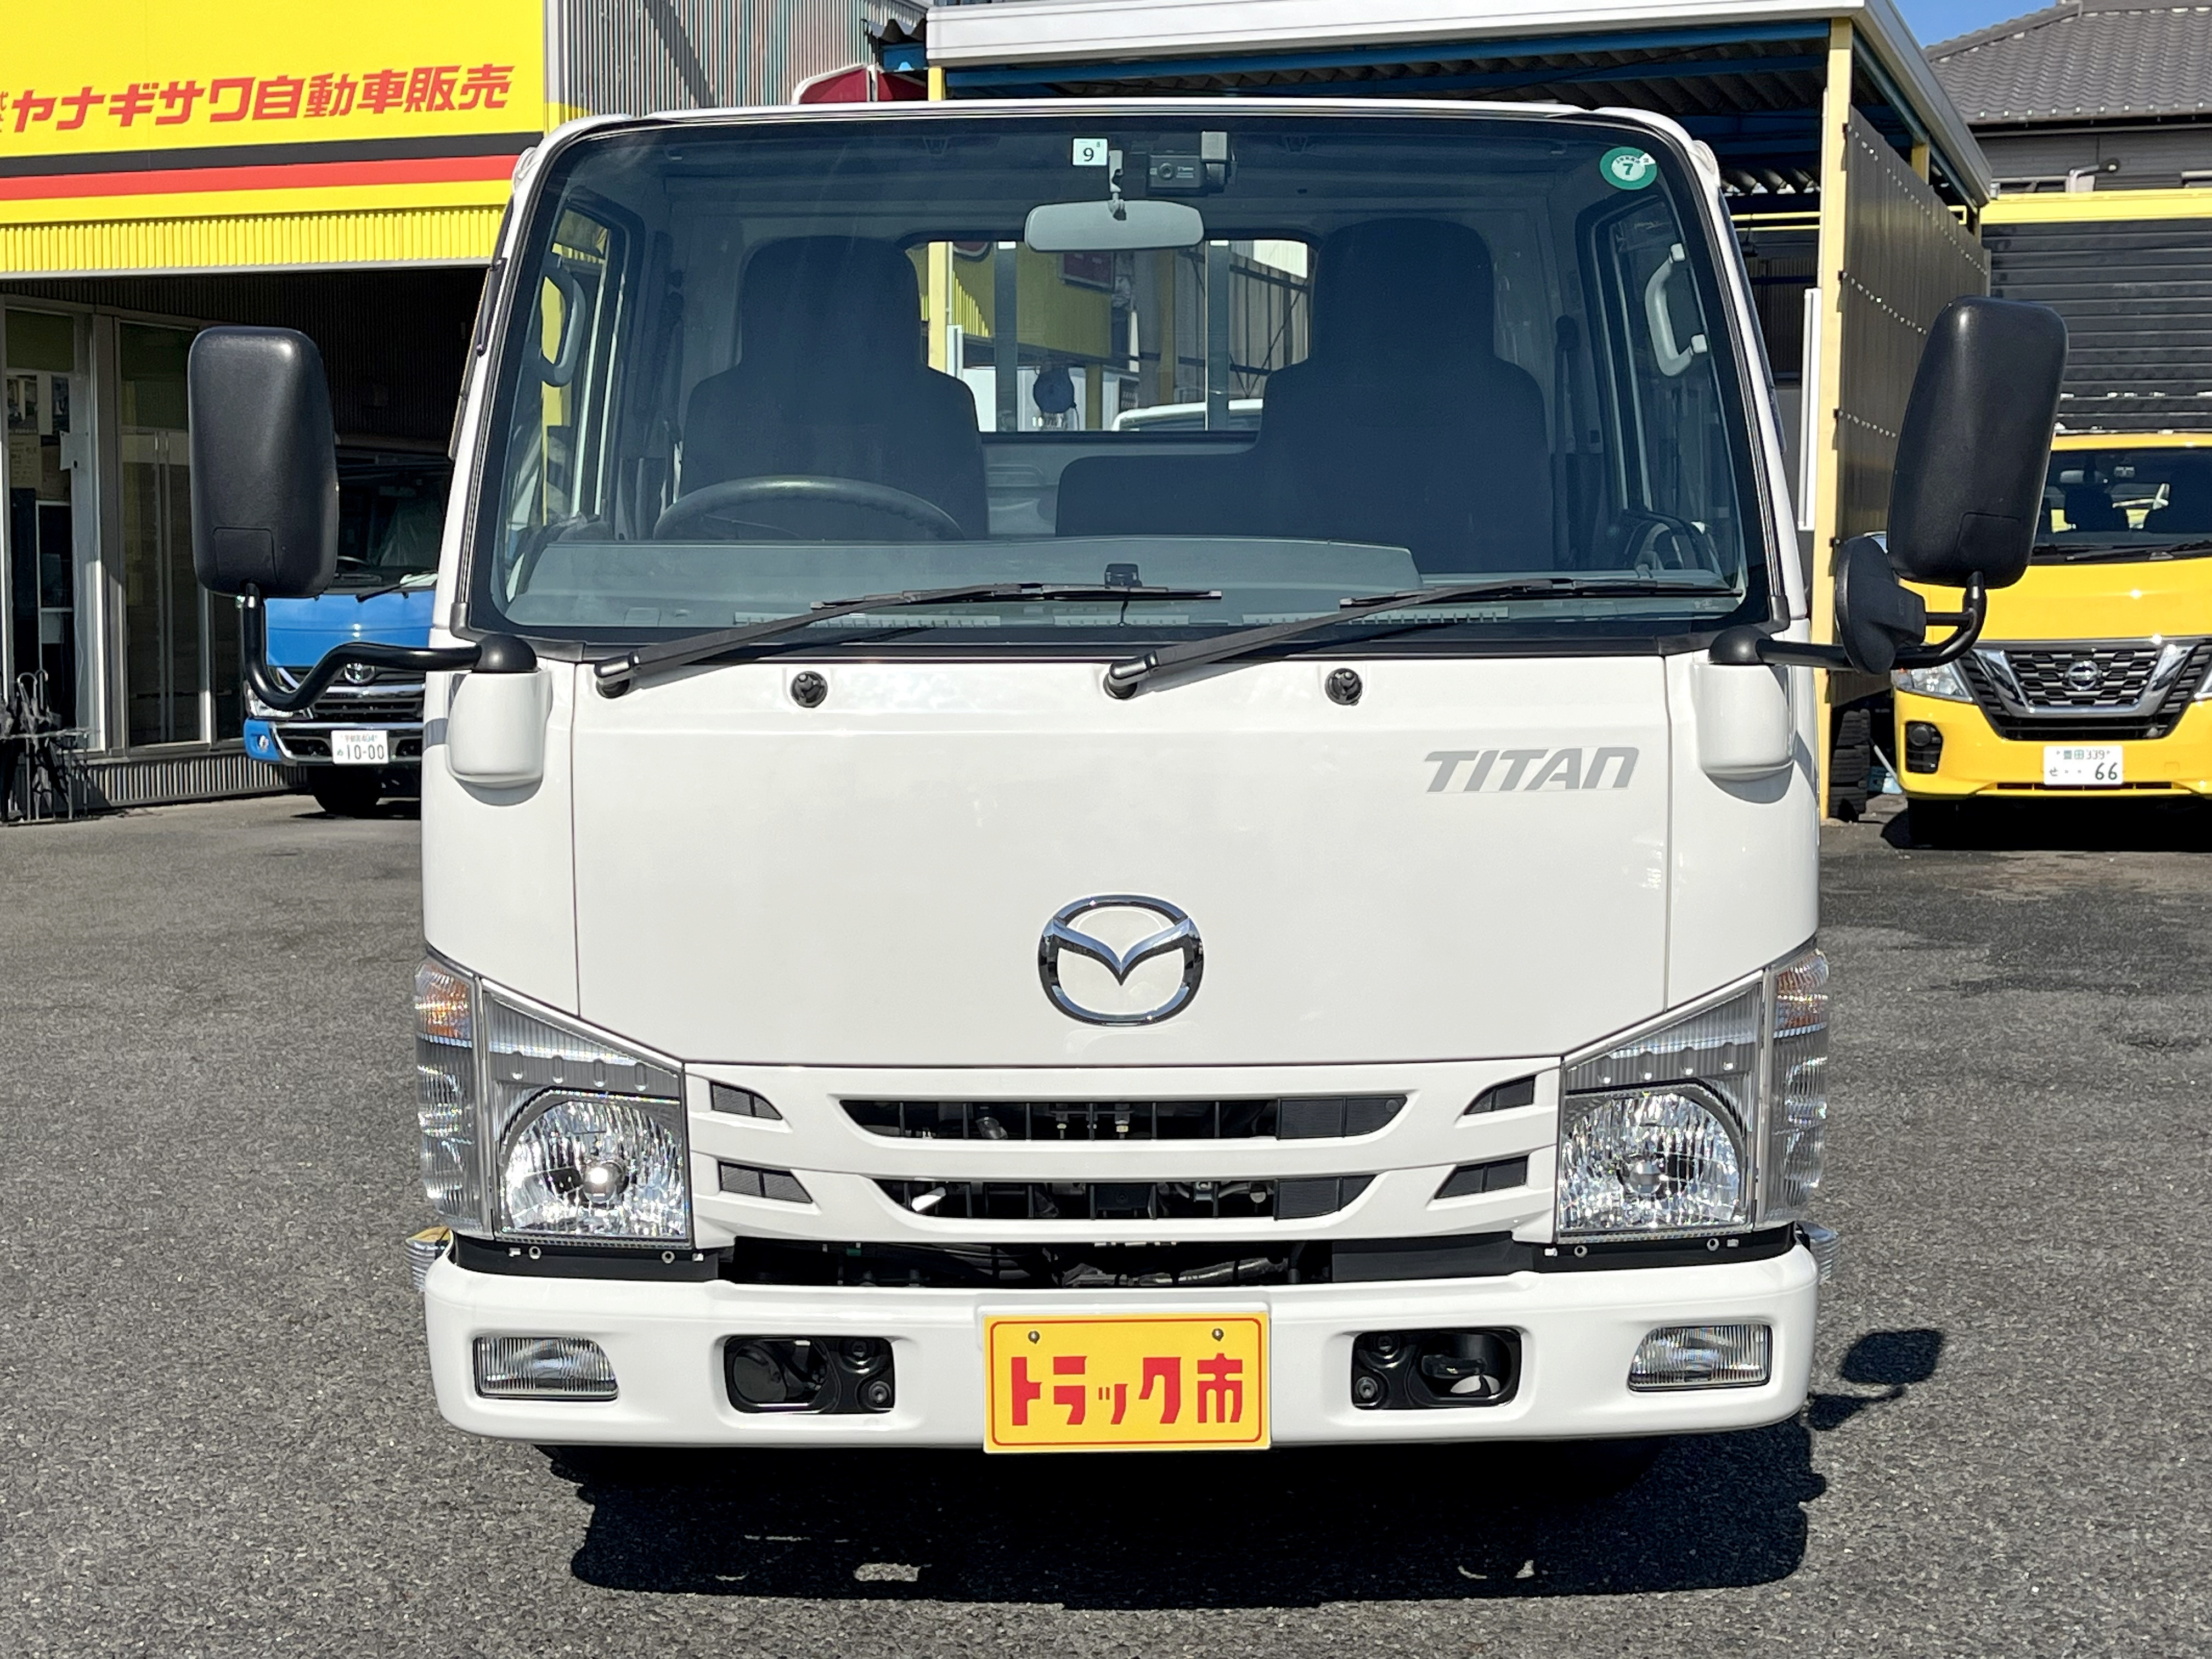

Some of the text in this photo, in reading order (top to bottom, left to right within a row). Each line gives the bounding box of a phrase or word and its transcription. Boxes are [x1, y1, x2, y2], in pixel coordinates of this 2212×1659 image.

[12, 64, 514, 133] ヤナギサワ自動車販売
[1083, 148, 1094, 162] 9
[1623, 163, 1633, 176] 7
[1425, 747, 1639, 792] TITAN
[1011, 1353, 1243, 1426] トラック市
